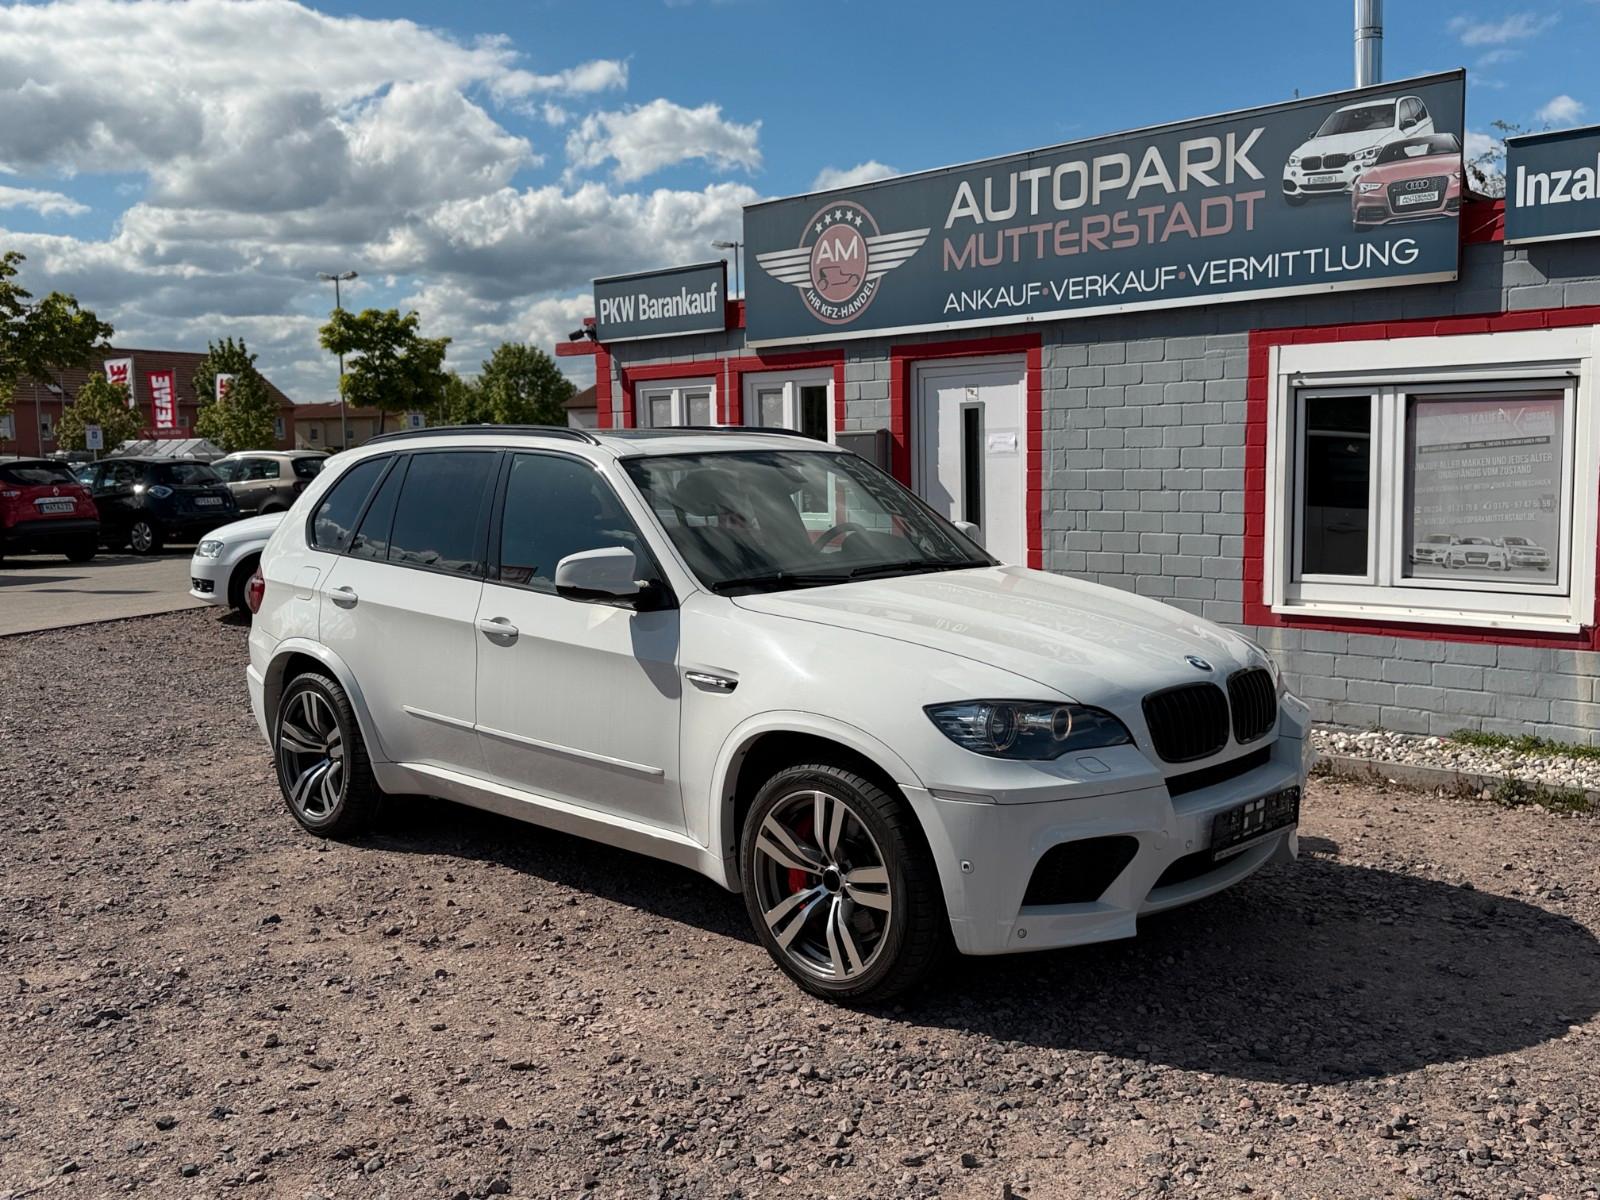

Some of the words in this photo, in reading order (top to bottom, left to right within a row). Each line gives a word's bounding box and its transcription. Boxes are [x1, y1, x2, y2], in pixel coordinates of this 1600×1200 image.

[944, 127, 1266, 229] AUTOPARK
[1515, 151, 1600, 208] Inza
[816, 235, 859, 265] AM
[943, 190, 1266, 272] MUTTERSTADT
[807, 289, 822, 310] IHR
[821, 280, 875, 319] KFZ-HANDEL
[943, 282, 1042, 314] ANKAUF
[1050, 265, 1178, 301] VERKAUF
[1187, 238, 1420, 286] VERMITTLUNG
[600, 295, 635, 325] PKW
[639, 282, 718, 321] Barankauf
[1492, 454, 1507, 465] UND
[1530, 452, 1553, 463] ALTER
